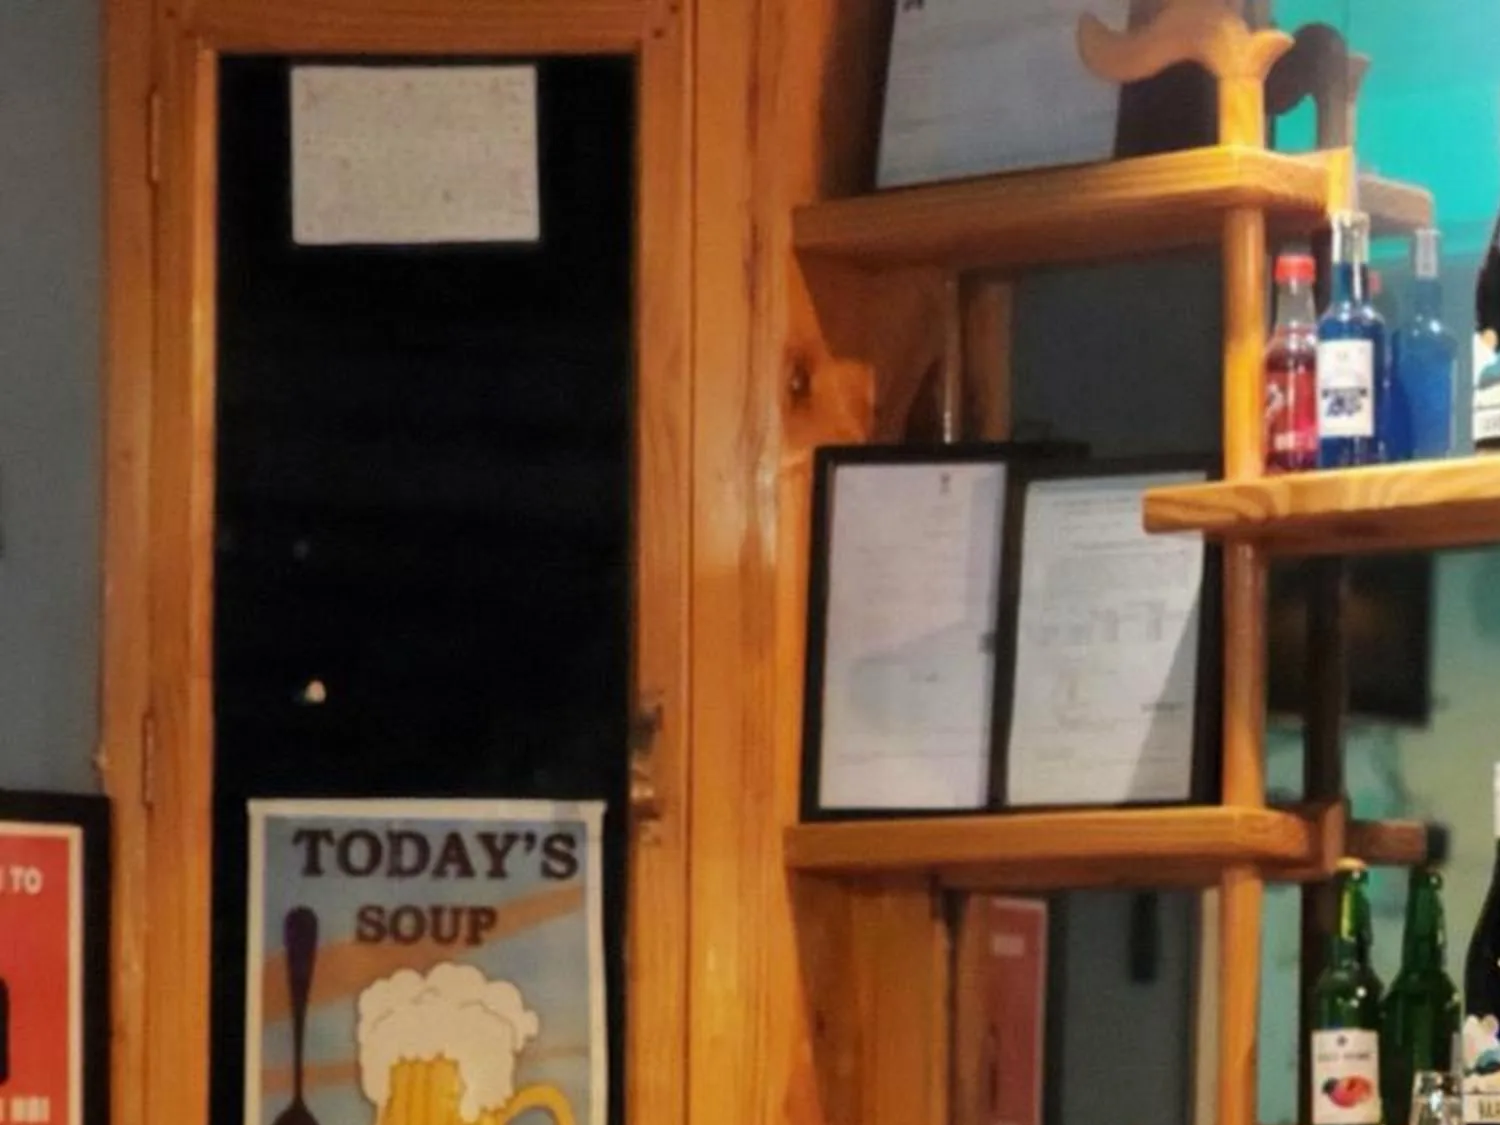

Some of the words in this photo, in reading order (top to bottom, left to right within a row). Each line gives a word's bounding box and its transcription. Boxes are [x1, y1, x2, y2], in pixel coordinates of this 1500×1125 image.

[292, 829, 580, 881] TODAY'S
[9, 864, 44, 895] TO
[354, 905, 498, 947] SOUP
